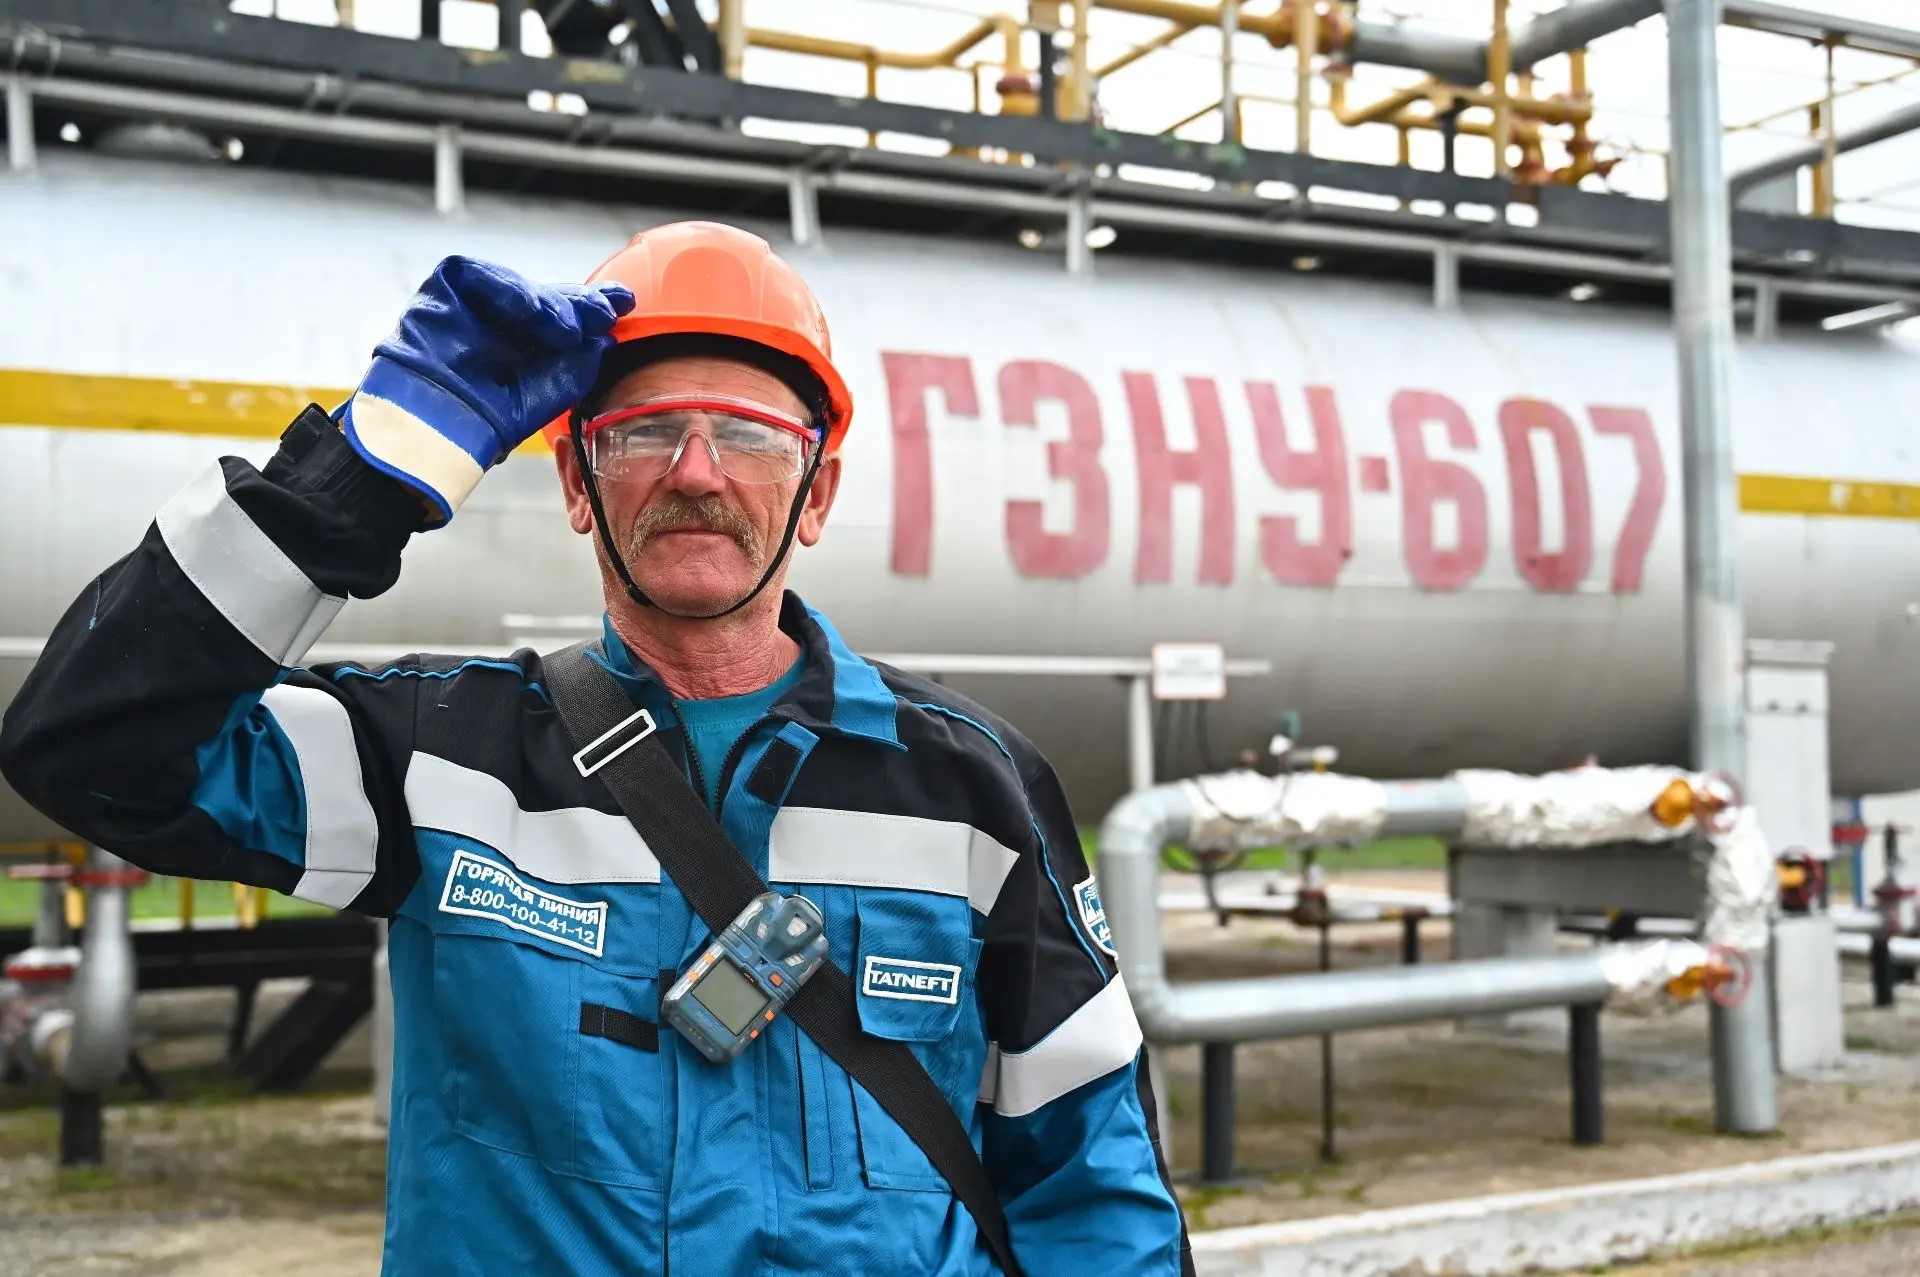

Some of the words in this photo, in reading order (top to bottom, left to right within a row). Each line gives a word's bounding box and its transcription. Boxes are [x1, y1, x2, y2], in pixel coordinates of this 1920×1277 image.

[881, 351, 1666, 594] ГЗНУ-607
[452, 885, 595, 945] 8-800-100-41-12
[456, 860, 534, 904] ГОРЯЧАЯ
[538, 897, 599, 925] ЛИНИЯ
[870, 970, 953, 991] TATNEFT
